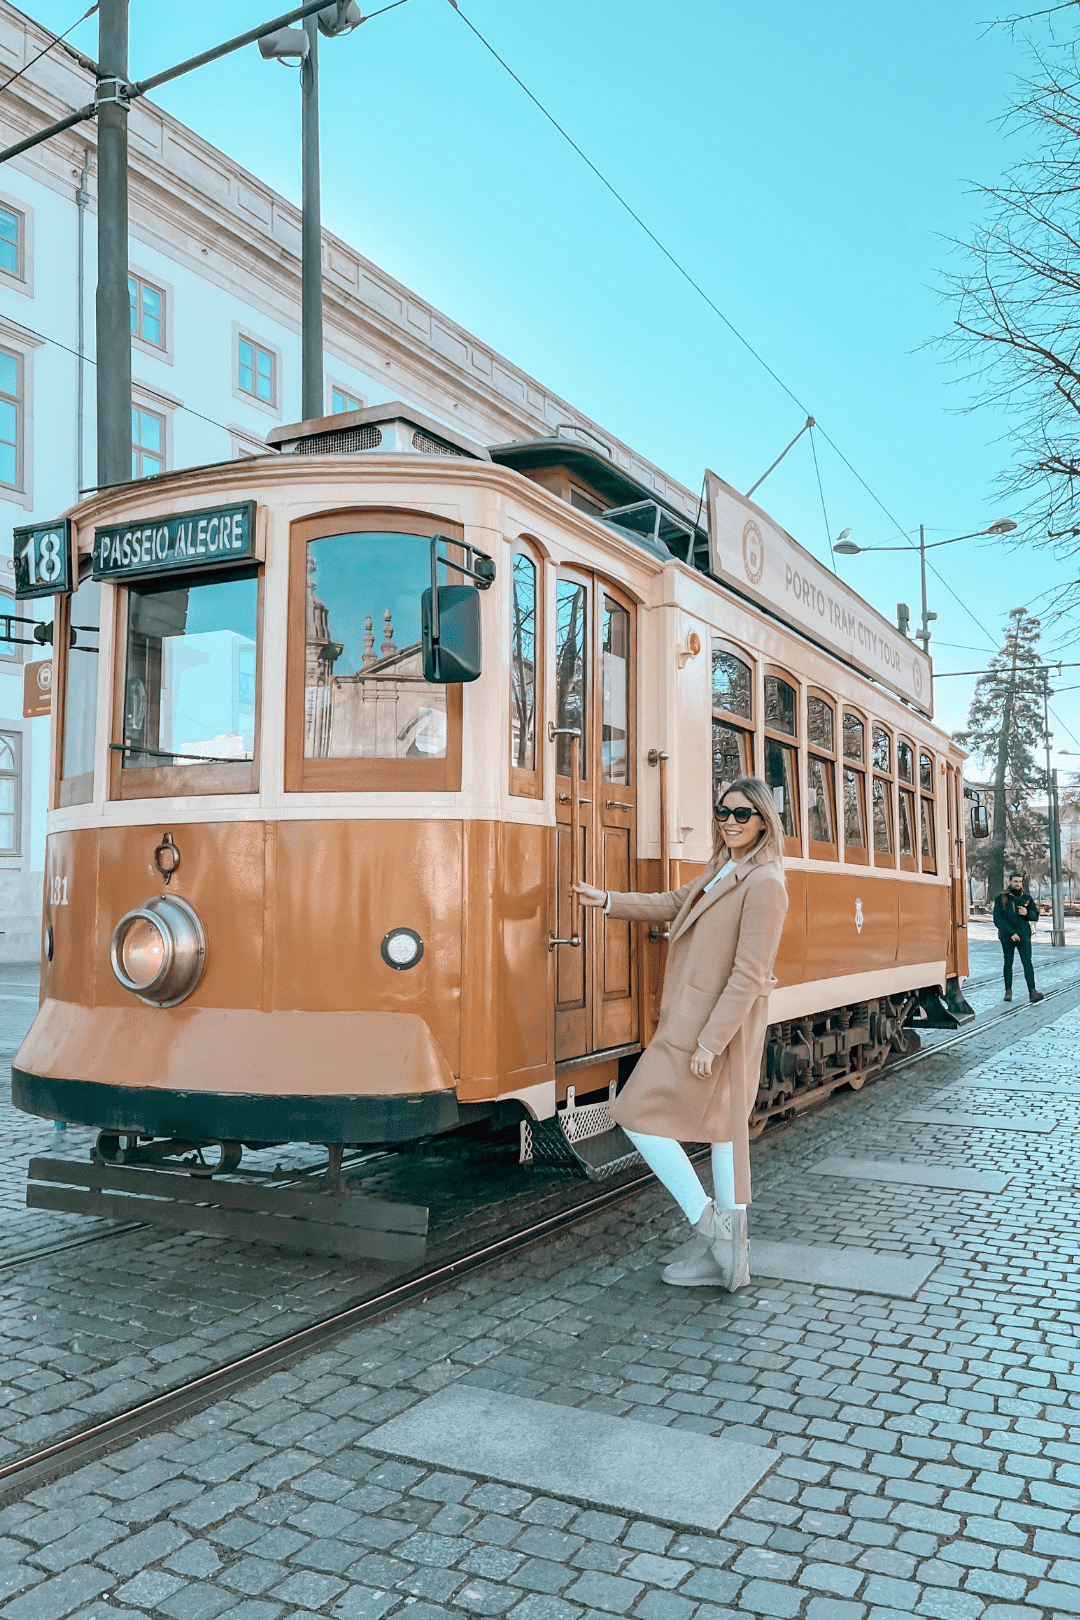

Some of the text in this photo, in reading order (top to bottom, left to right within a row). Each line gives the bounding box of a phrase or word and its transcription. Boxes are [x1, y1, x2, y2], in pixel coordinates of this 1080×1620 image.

[20, 533, 62, 585] 18
[100, 513, 243, 569] PASSEIO ALEGRE
[785, 563, 901, 673] PORTO TRAM CITY TOUR
[50, 875, 69, 906] 131
